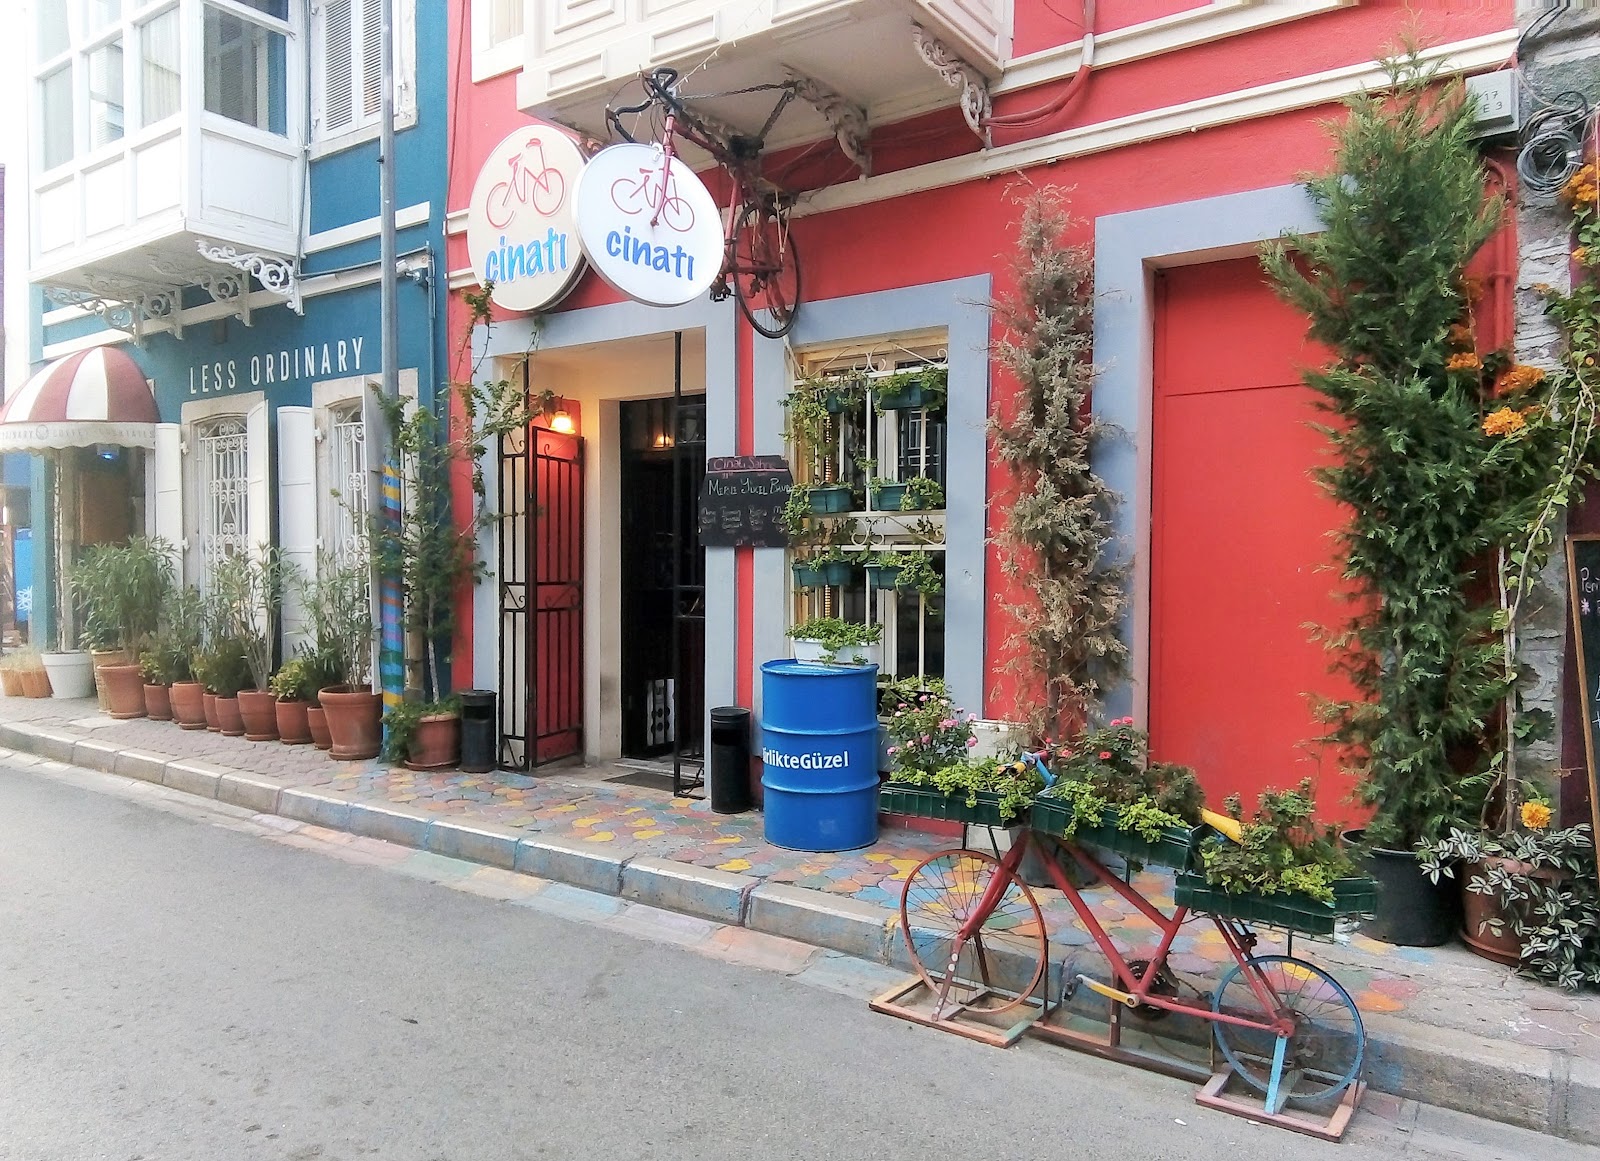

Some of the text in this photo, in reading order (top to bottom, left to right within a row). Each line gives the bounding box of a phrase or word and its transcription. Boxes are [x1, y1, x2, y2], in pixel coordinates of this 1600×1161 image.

[189, 337, 363, 395] LESS ORDINARY
[763, 747, 849, 769] irlikteGüzel
